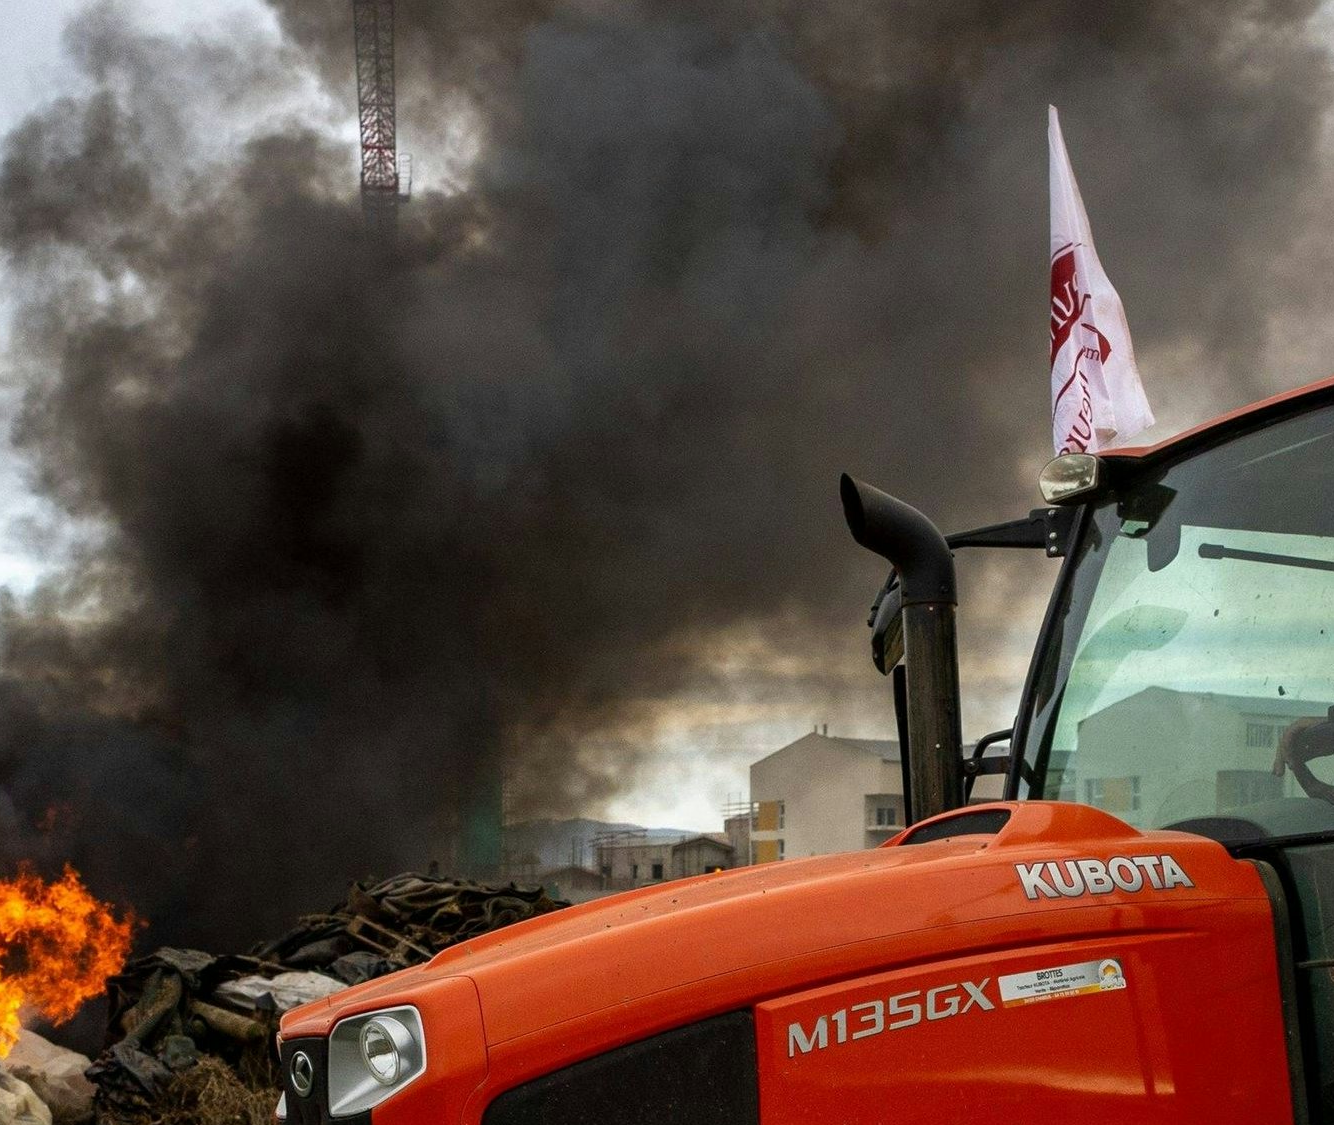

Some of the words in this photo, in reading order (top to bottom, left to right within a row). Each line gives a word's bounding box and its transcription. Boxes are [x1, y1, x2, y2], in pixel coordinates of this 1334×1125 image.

[1015, 855, 1194, 900] KUBOTA
[1036, 969, 1063, 980] BROTTES
[788, 977, 996, 1058] M135GX
